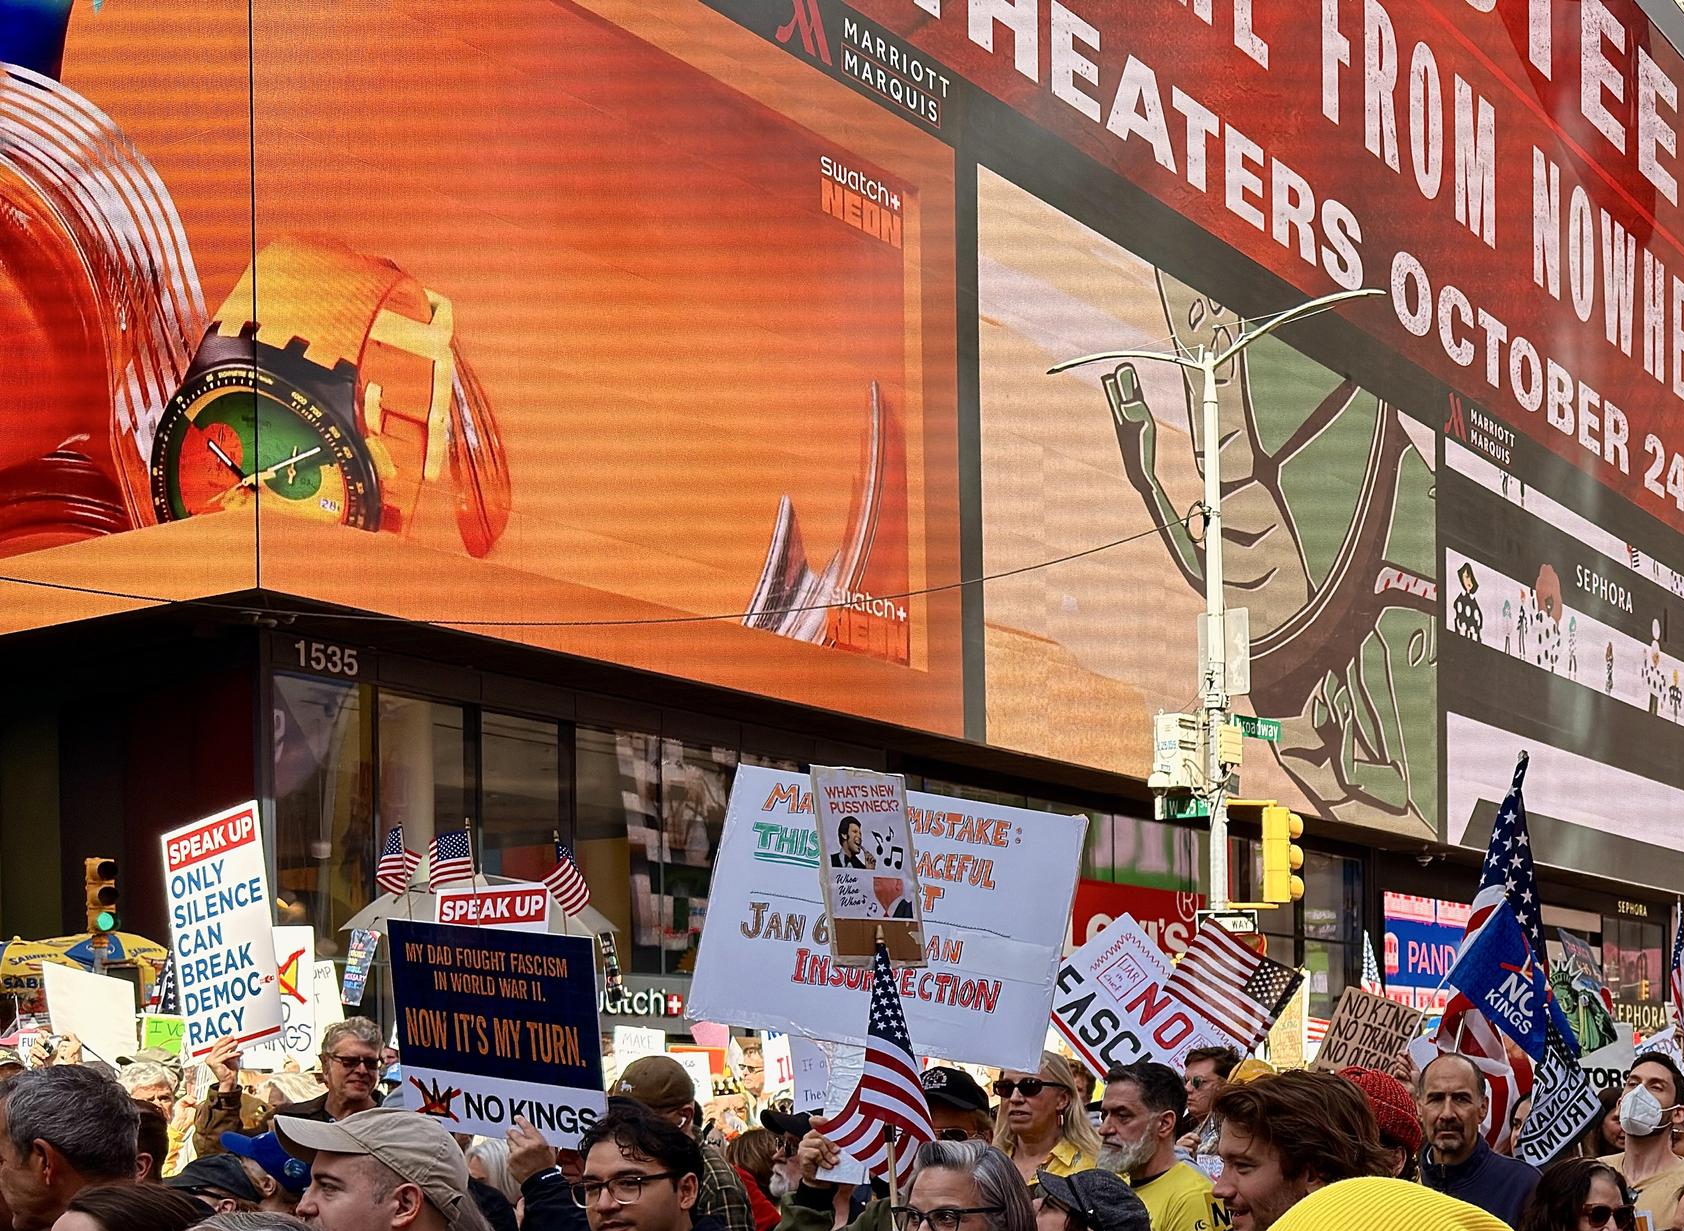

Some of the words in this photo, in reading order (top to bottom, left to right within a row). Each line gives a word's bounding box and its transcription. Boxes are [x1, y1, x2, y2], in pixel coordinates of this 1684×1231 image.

[844, 17, 950, 98] MARRIOTT
[844, 49, 939, 122] MARQUIS
[1320, 0, 1496, 249] FROM
[821, 177, 902, 249] NEON
[1390, 251, 1631, 476] OCTOBER
[1471, 408, 1515, 447] MARRIOTT
[1471, 429, 1511, 465] MARQUIS
[1576, 564, 1634, 614] SEPHORA
[294, 638, 360, 677] 1535
[824, 785, 869, 799] WHAT'S
[871, 785, 895, 798] NEW
[829, 800, 899, 814] PUSSYNECK?
[169, 828, 227, 865] SPEAK
[228, 816, 254, 841] UP
[752, 822, 819, 859] THIS
[172, 860, 225, 898] ONLY
[836, 874, 857, 885] Whoa
[839, 885, 860, 896] Whoa
[174, 877, 263, 928] SILENCE
[441, 897, 510, 922] SPEAK
[515, 895, 545, 916] UP
[841, 896, 862, 908] Whoa
[1618, 900, 1648, 917] SEPHORA
[178, 923, 223, 958] CAN
[741, 903, 806, 944] JAN
[925, 936, 963, 965] AN
[1231, 920, 1249, 929] WAY
[182, 944, 254, 987] BREAK
[405, 942, 425, 963] MY
[427, 946, 452, 966] DAD
[456, 949, 505, 971] FOUGHT
[510, 953, 568, 978] FASCISM
[1117, 957, 1140, 983] LIAR
[185, 971, 262, 1017] DEMOC
[433, 970, 448, 991] IN
[450, 972, 496, 996] WORLD
[499, 978, 528, 1000] WAR
[530, 980, 547, 1002] II.
[189, 1007, 245, 1046] RACY
[1125, 981, 1195, 1050] NO
[1334, 1018, 1360, 1041] NO
[1341, 991, 1369, 1019] NO
[1370, 999, 1427, 1038] KINGS
[1484, 988, 1533, 1035] KINGS
[405, 1007, 447, 1049] NOW
[453, 1012, 488, 1055] IT'S
[494, 1017, 522, 1060] MY
[526, 1021, 587, 1067] TURN.
[1324, 1040, 1350, 1063] NO
[464, 1091, 505, 1123] NO
[508, 1098, 598, 1134] KINGS
